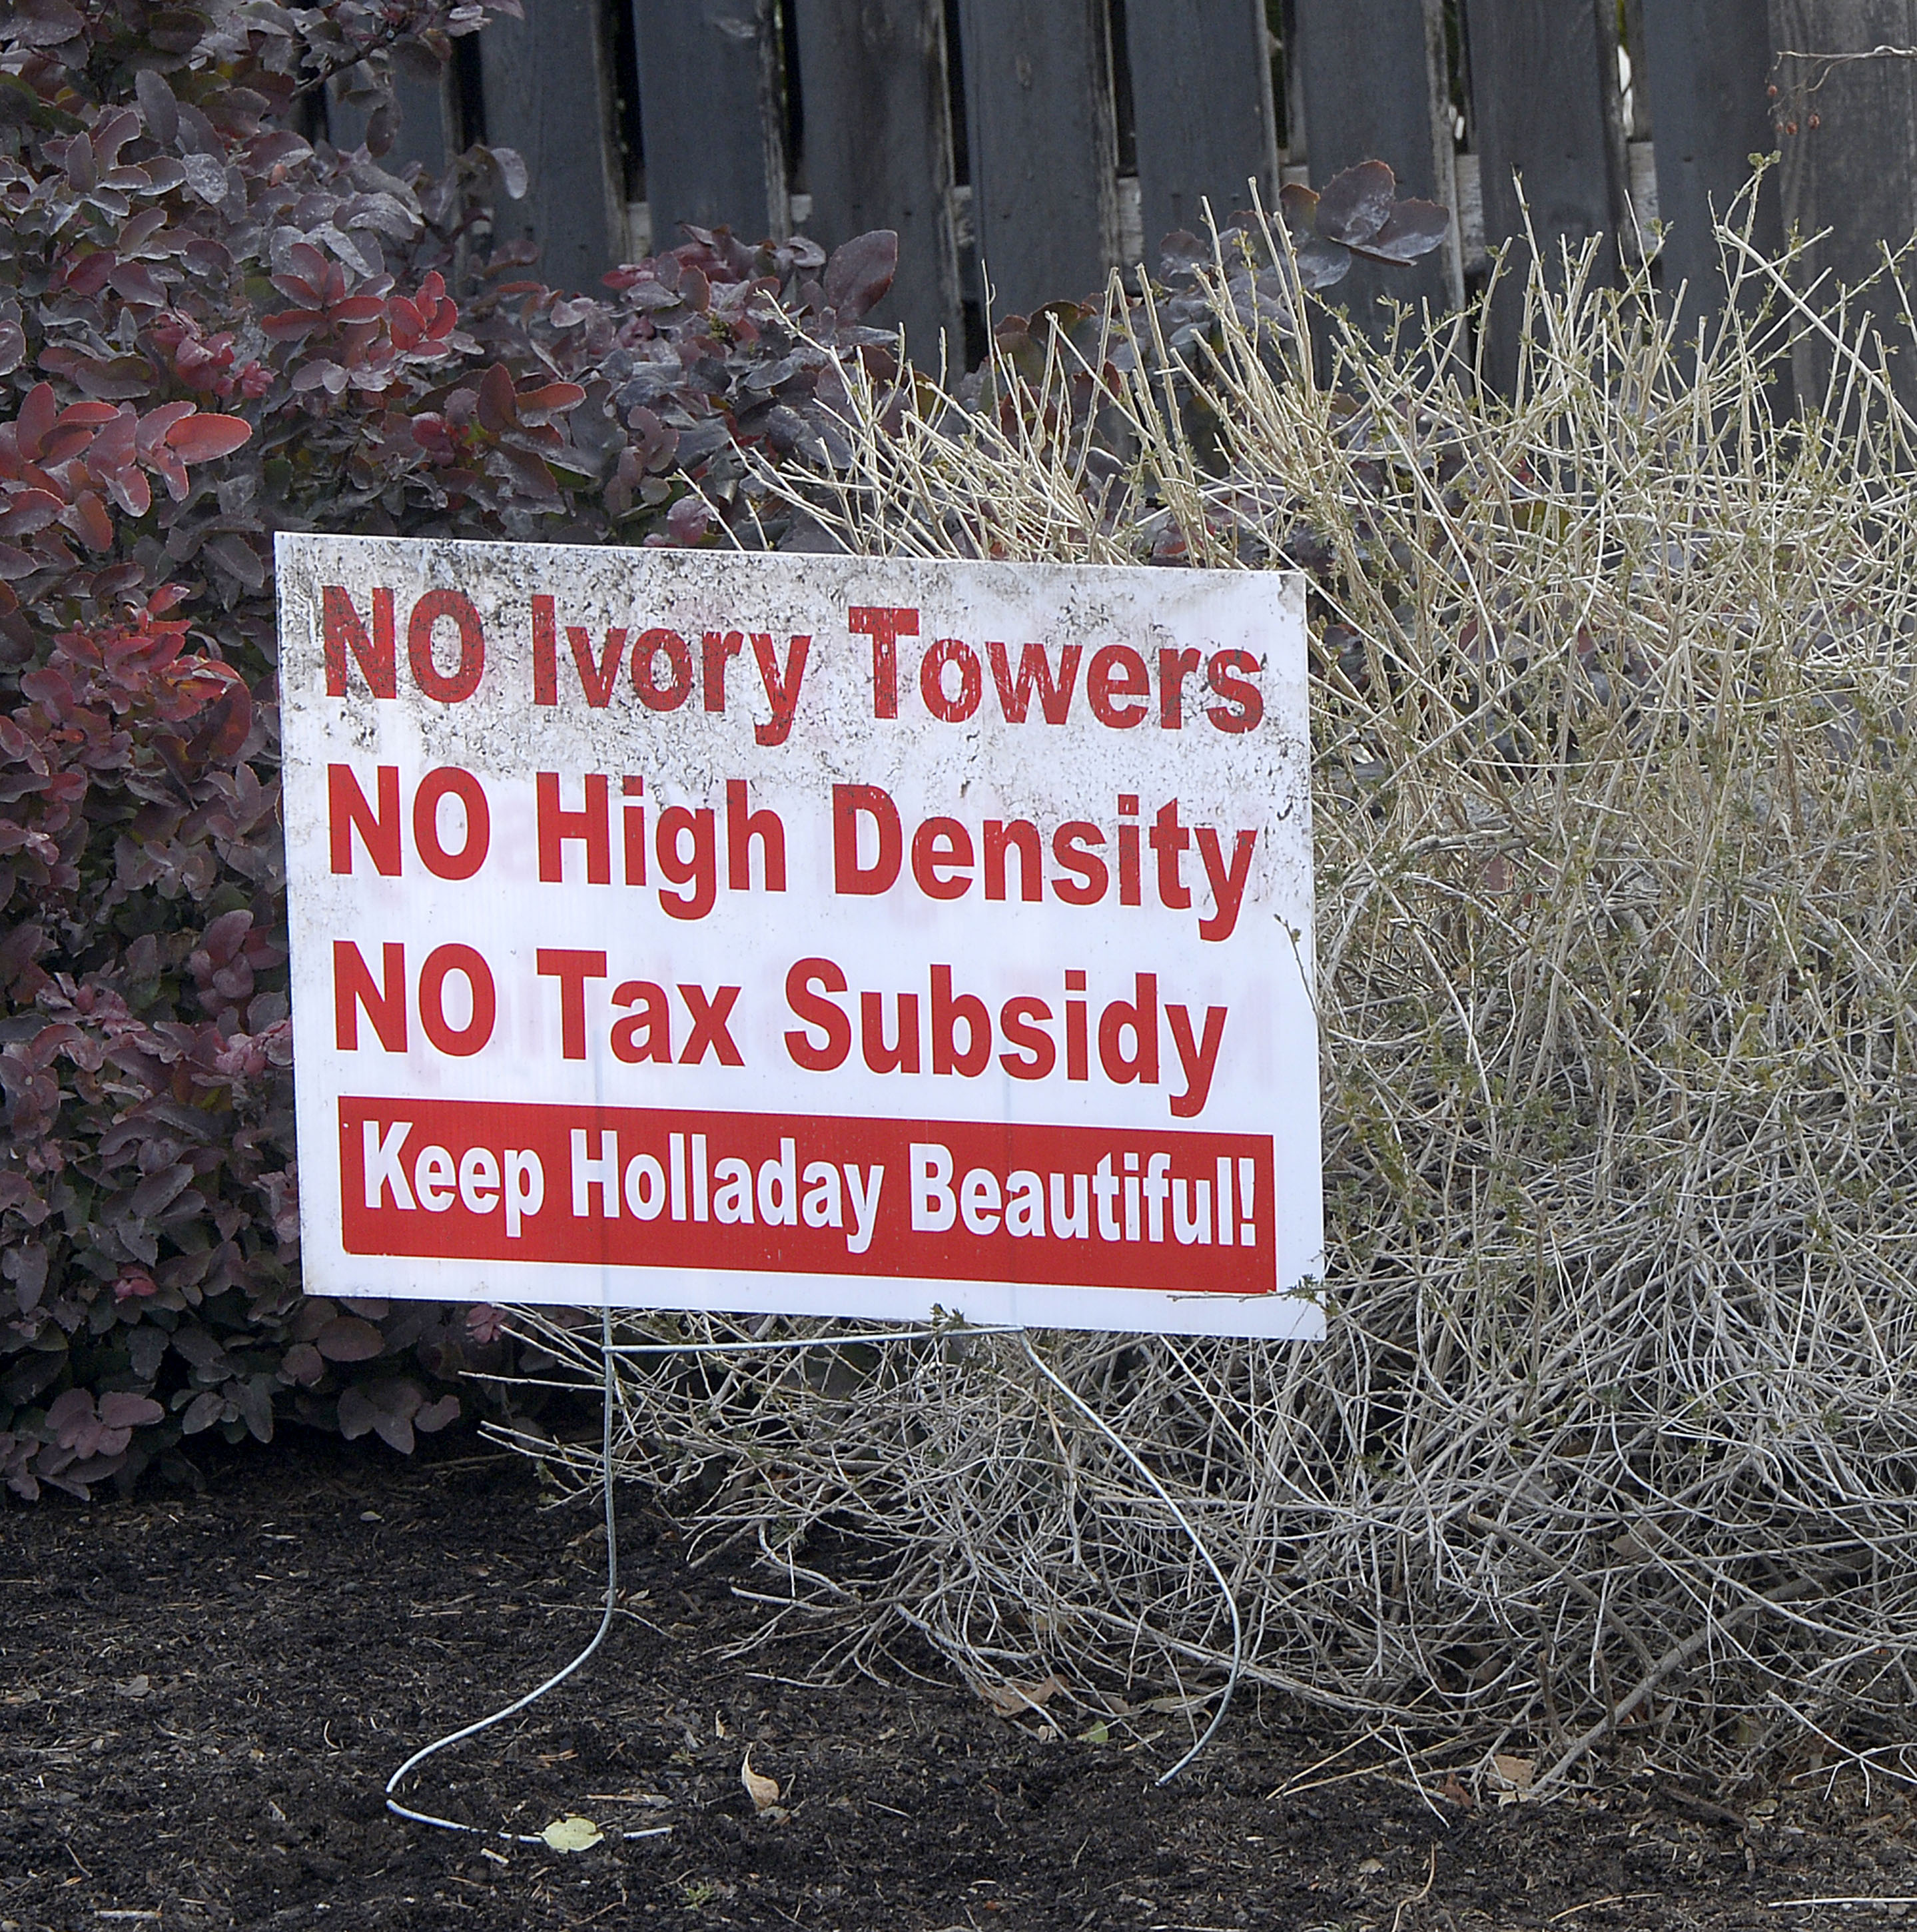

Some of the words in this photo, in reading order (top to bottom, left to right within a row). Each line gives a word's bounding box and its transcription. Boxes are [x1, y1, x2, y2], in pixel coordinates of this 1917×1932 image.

[324, 587, 484, 703] NO
[533, 596, 810, 745] Ivory
[849, 608, 1262, 733] Towers
[328, 764, 489, 880] NO
[537, 773, 785, 920] High
[833, 785, 1257, 941] Density
[334, 941, 495, 1057] NO
[537, 949, 743, 1066] Tax
[785, 959, 1227, 1117] Subsidy
[362, 1119, 544, 1238] Keep
[570, 1128, 885, 1254] Holladay
[909, 1143, 1256, 1247] Beautiful!
